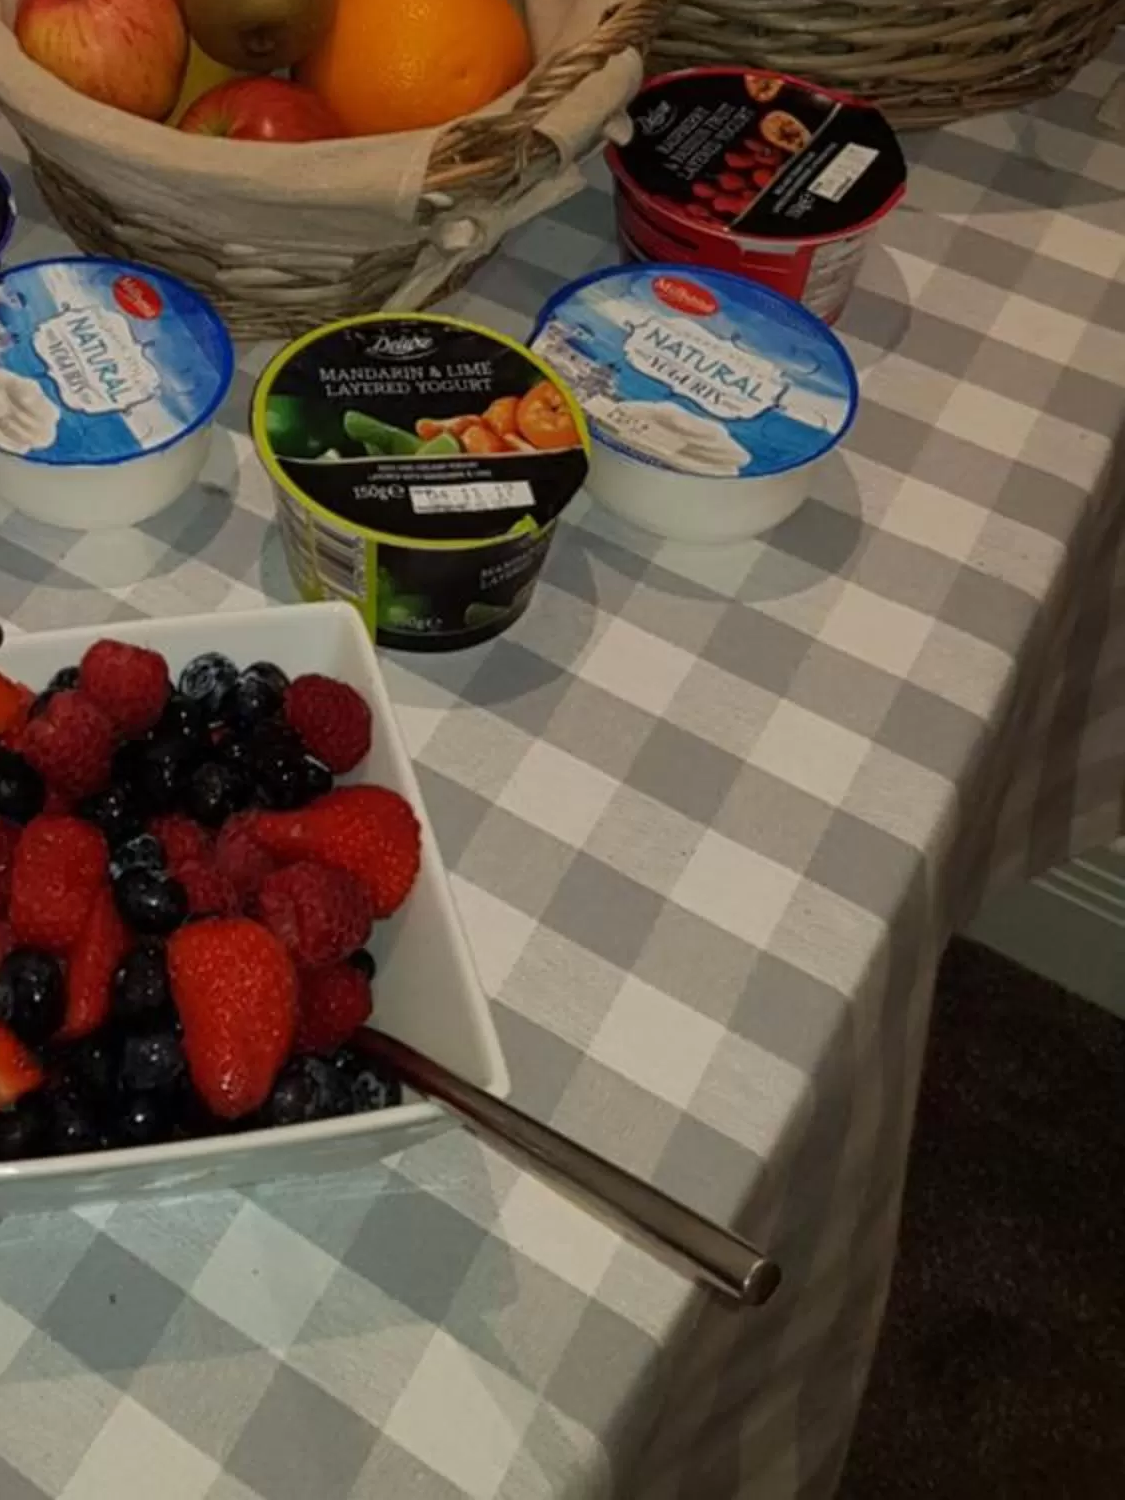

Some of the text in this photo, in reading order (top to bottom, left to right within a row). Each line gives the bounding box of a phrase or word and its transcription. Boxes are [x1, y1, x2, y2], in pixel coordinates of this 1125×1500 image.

[369, 334, 437, 356] Deluxe
[68, 314, 130, 404] NATURAL
[644, 325, 763, 403] NATURAL
[318, 361, 494, 384] MANDARIN & LIME
[325, 377, 493, 398] LAYERED YOGURT
